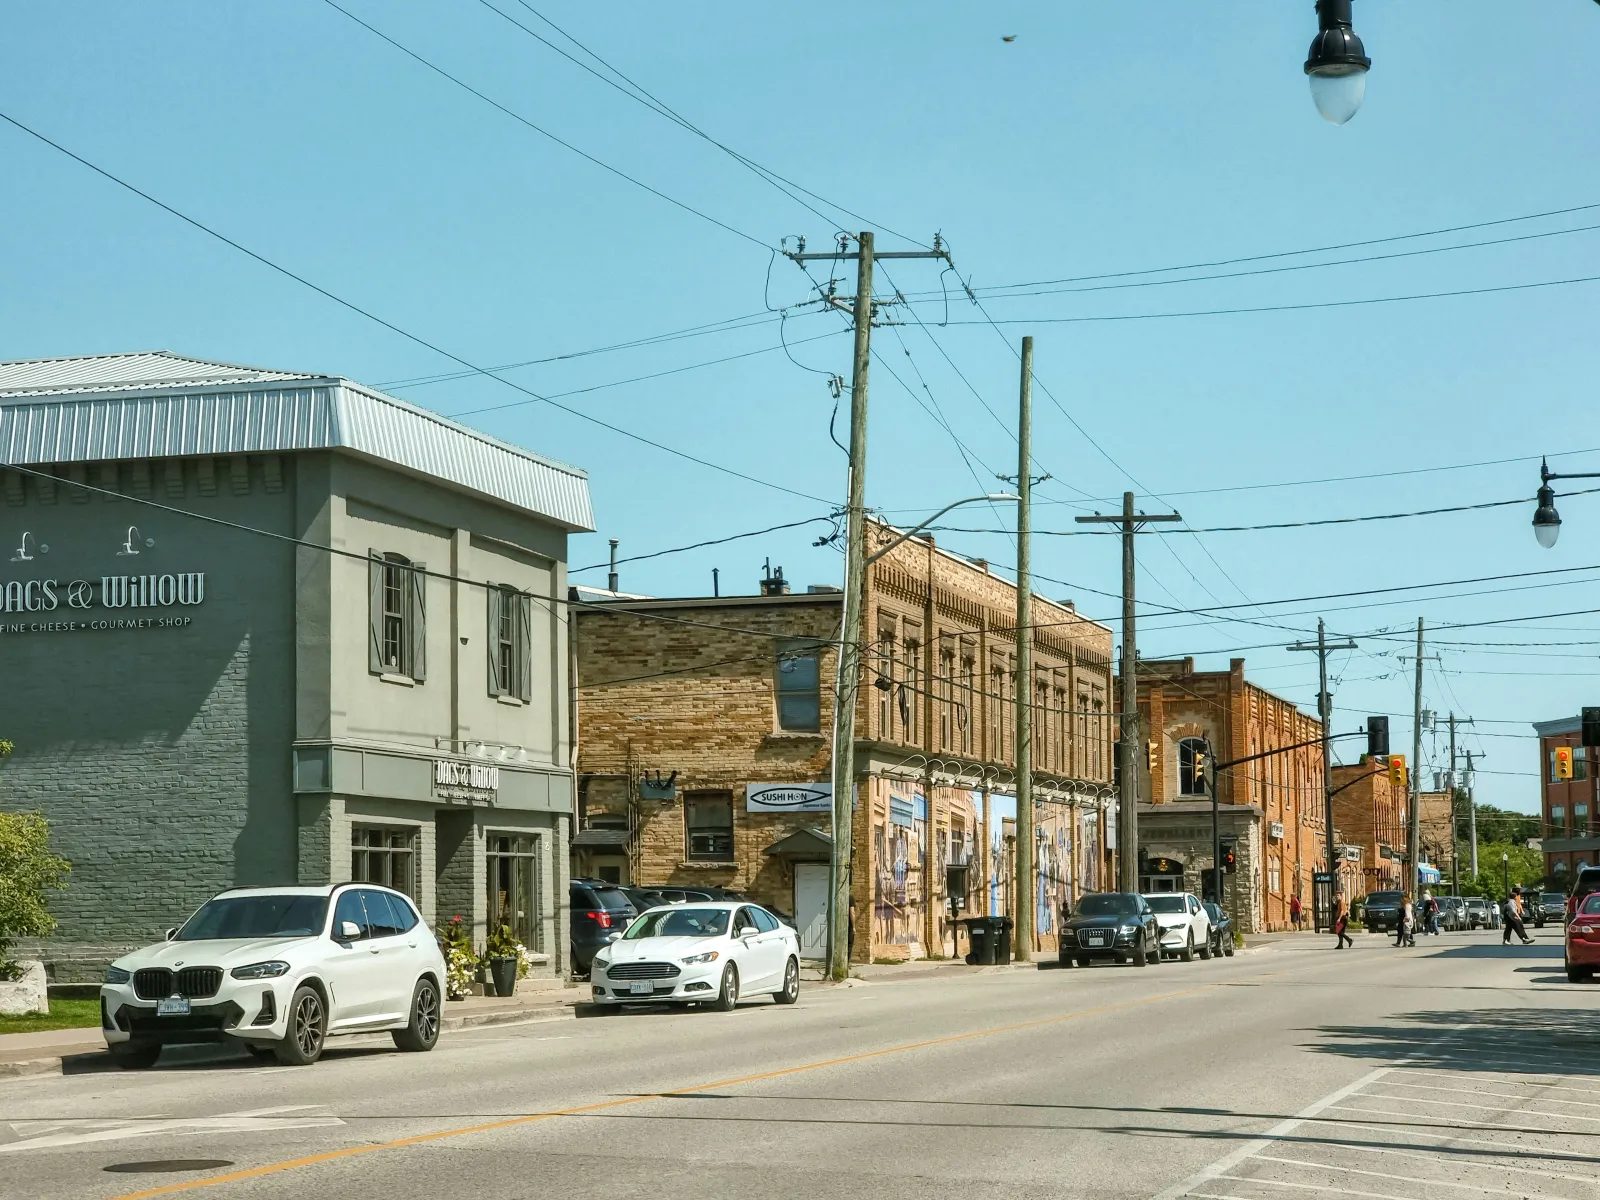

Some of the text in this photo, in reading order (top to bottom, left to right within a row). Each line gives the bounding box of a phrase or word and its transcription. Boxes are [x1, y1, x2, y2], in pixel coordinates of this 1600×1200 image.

[0, 579, 58, 612] AGS
[68, 580, 92, 608] &
[0, 617, 191, 633] FINE CHEESE GOURMET SHOP
[437, 761, 459, 785] DAGS
[461, 766, 468, 786] &
[762, 793, 807, 801] SUSHI HON
